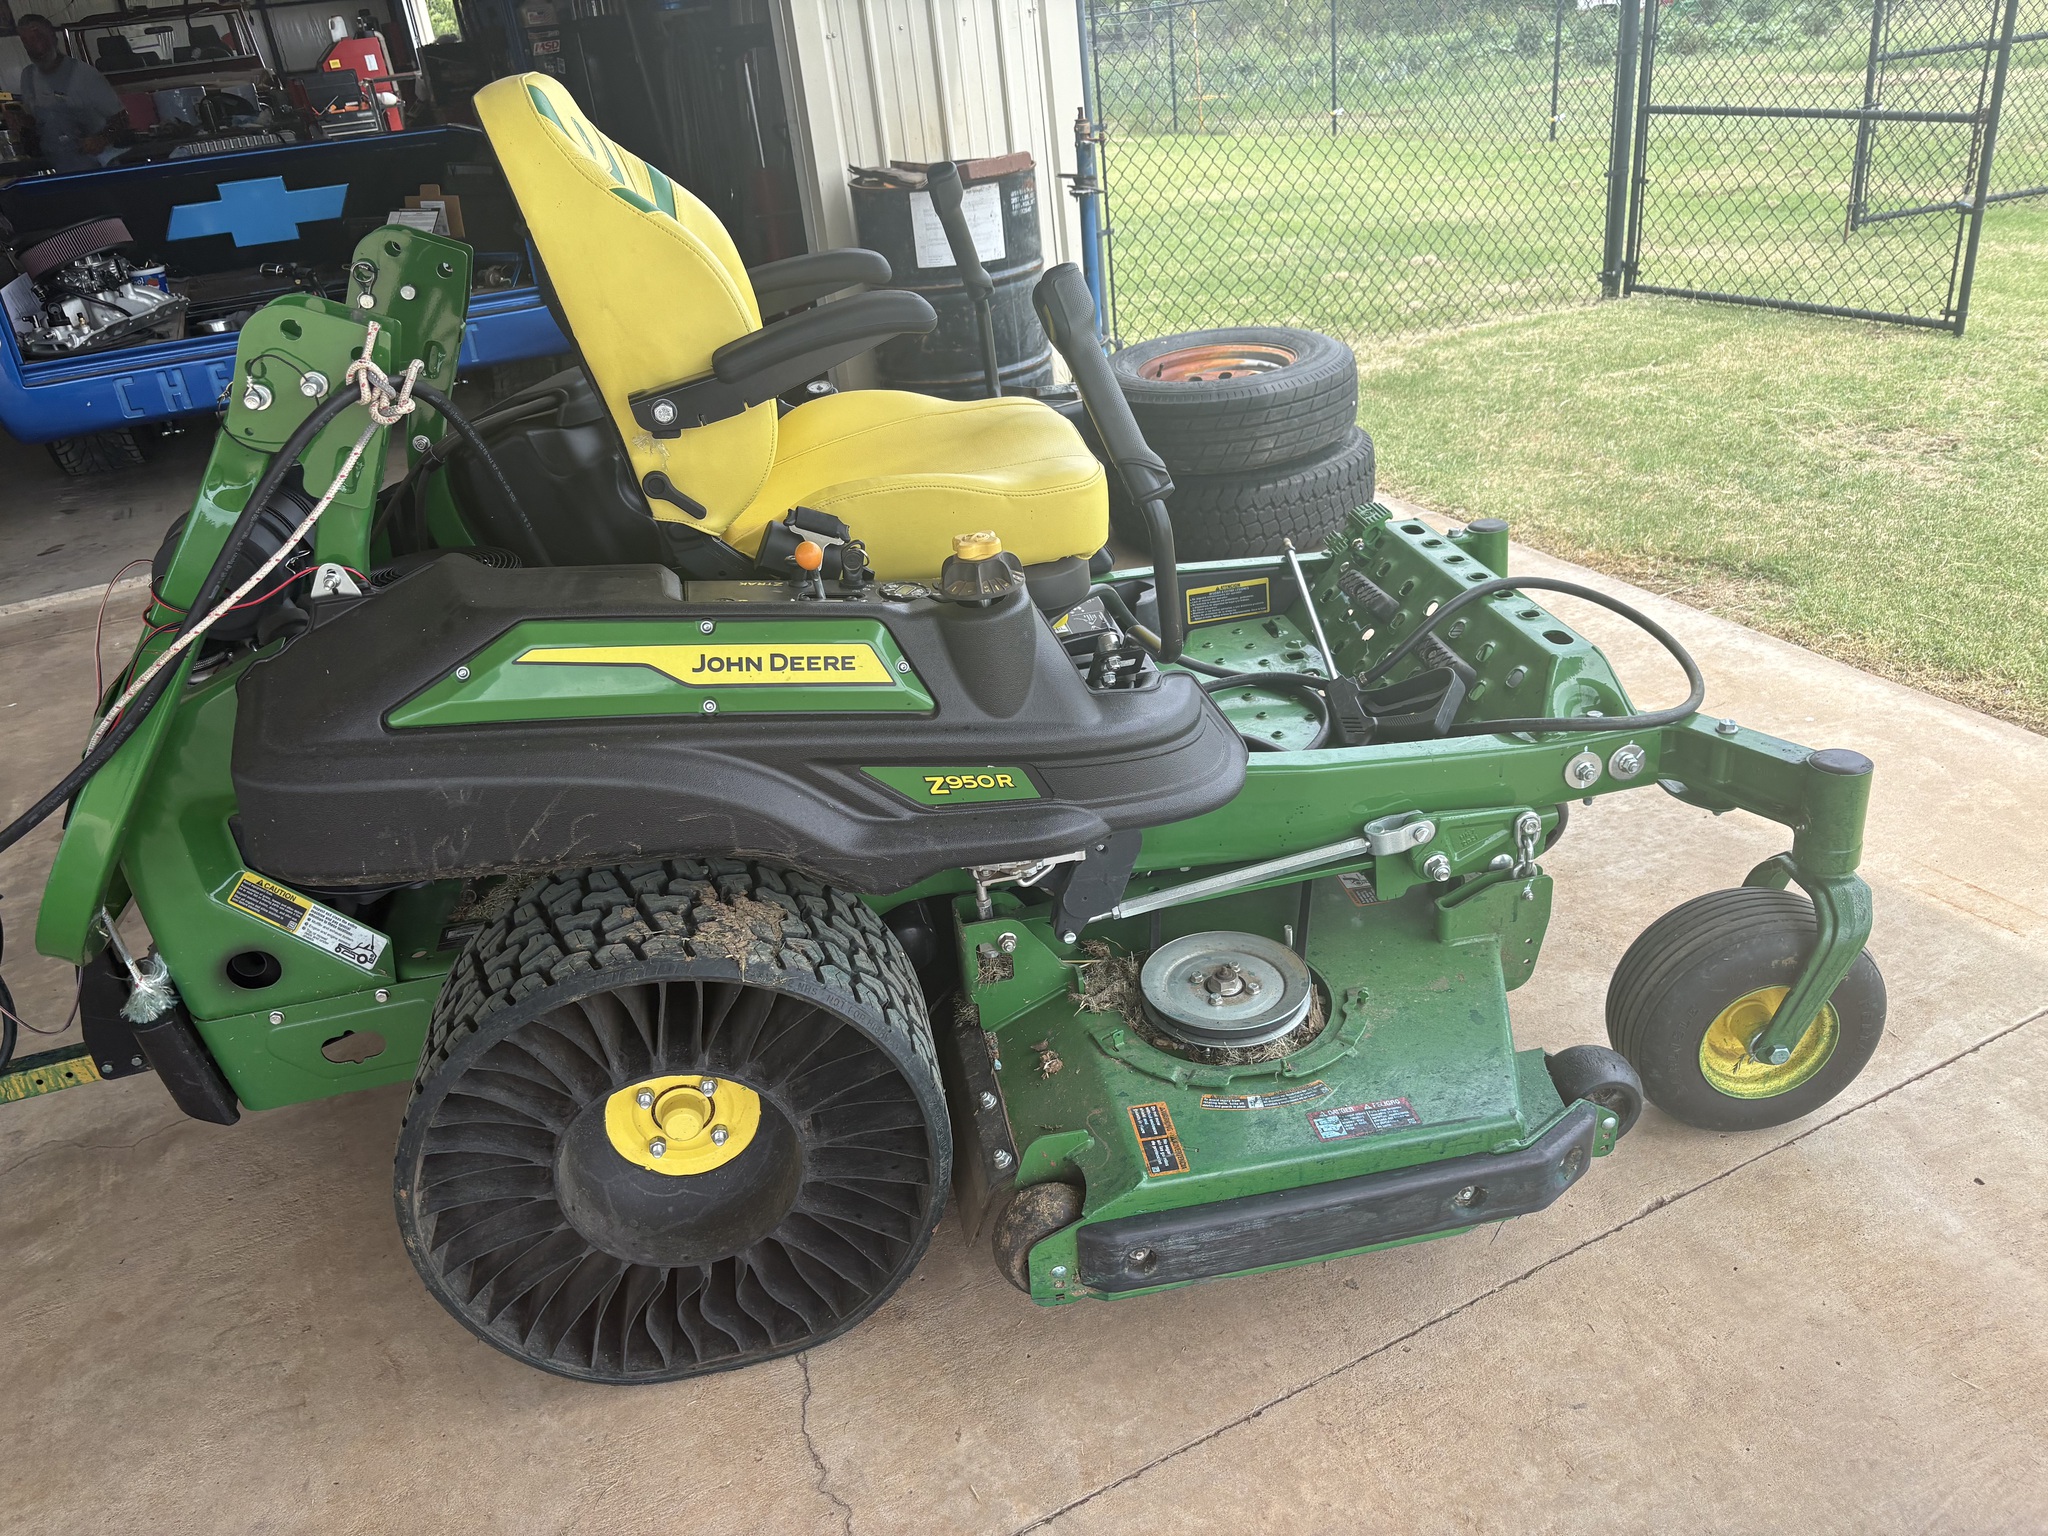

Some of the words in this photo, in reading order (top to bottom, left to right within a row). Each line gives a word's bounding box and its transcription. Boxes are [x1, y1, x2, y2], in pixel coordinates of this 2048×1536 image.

[692, 654, 762, 673] JOHN
[769, 653, 856, 671] DEERE
[923, 774, 1016, 795] Z950R
[263, 883, 297, 902] CAUTION
